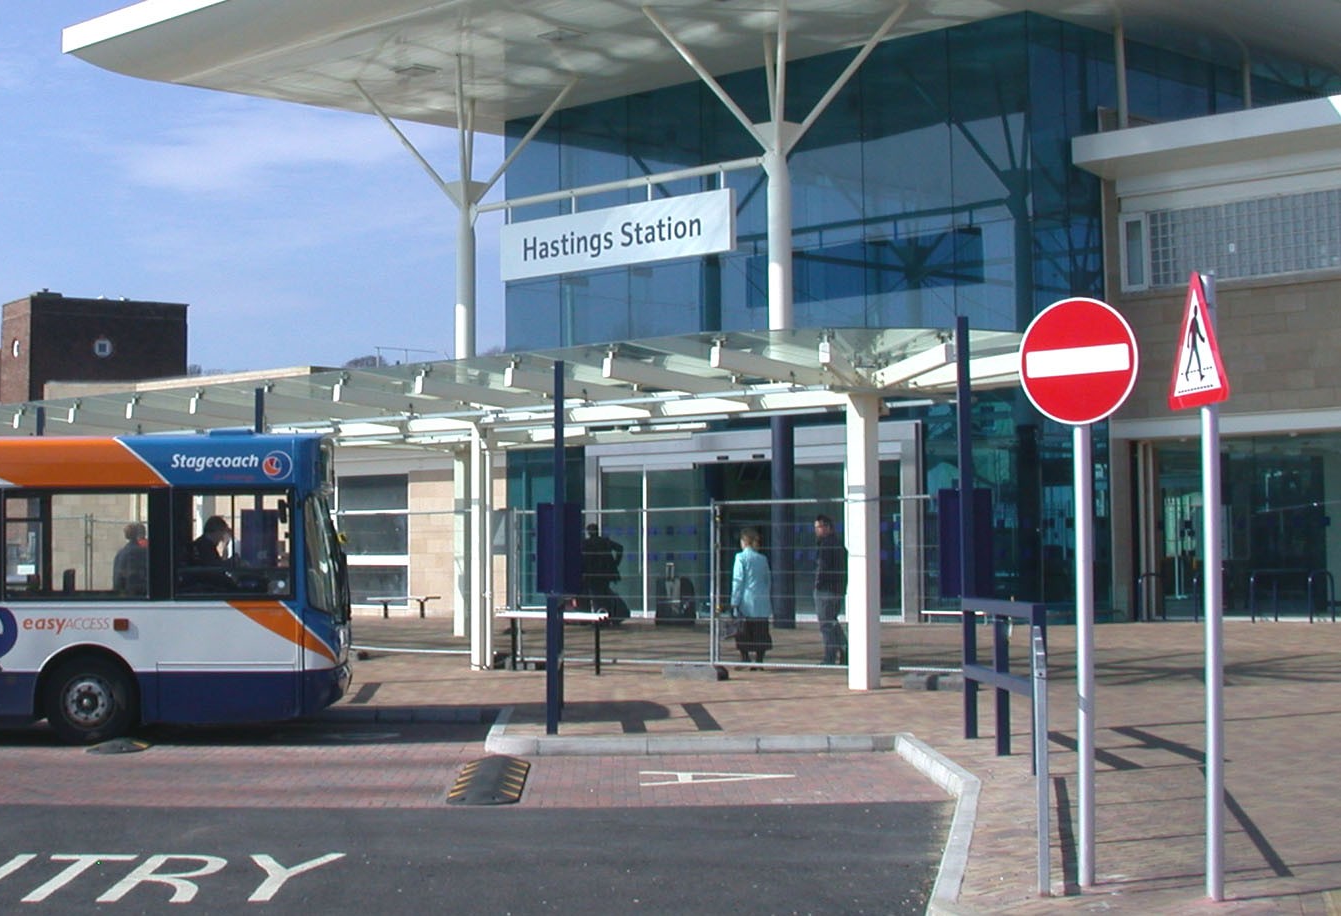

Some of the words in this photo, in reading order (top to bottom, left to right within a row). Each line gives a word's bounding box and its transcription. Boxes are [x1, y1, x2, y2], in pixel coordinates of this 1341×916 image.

[523, 231, 613, 262] Hastings
[620, 216, 702, 248] Station
[170, 453, 259, 472] Stagecoach
